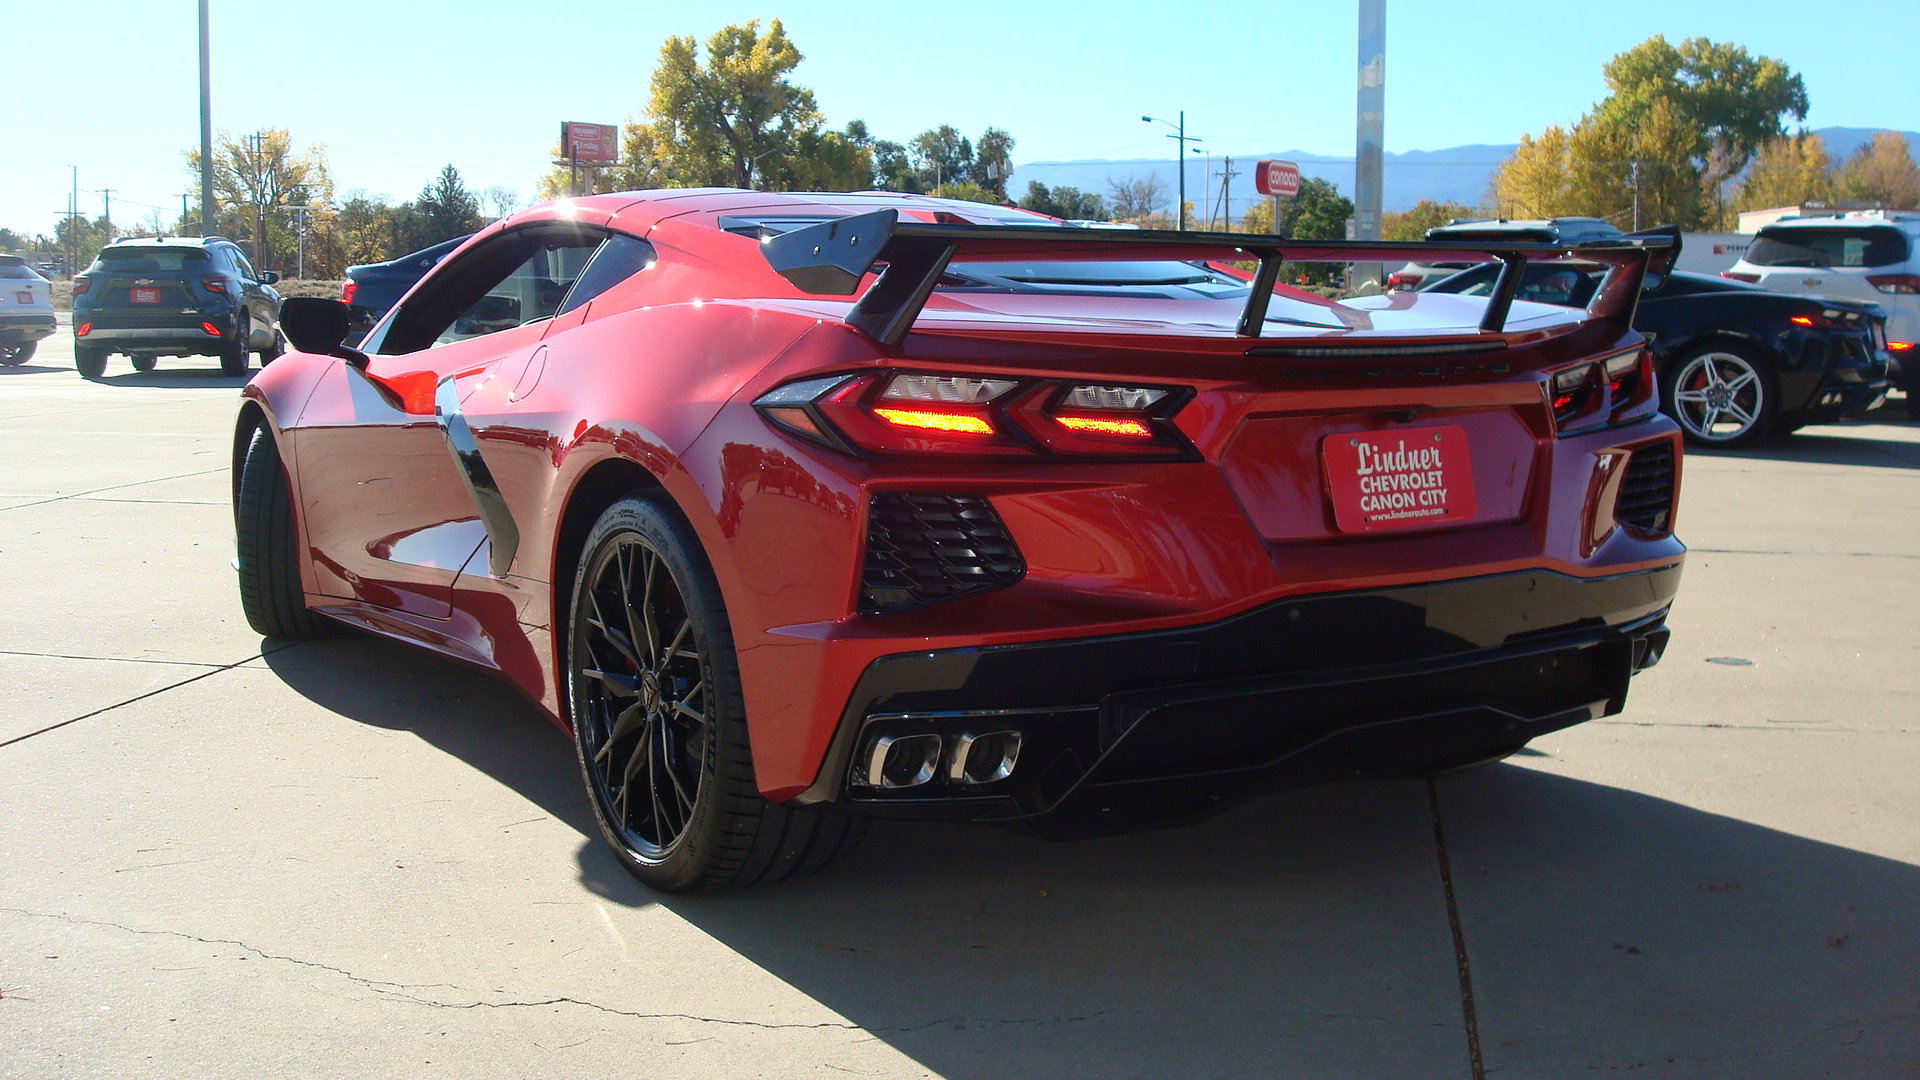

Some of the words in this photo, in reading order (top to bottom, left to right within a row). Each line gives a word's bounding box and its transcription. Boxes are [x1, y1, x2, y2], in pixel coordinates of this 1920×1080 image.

[1357, 440, 1442, 475] Lindner
[1360, 471, 1443, 493] CHEVROLET
[1360, 493, 1416, 511] CANON
[1419, 489, 1447, 505] CITY
[1371, 508, 1443, 521] www.lindnerauto.com
